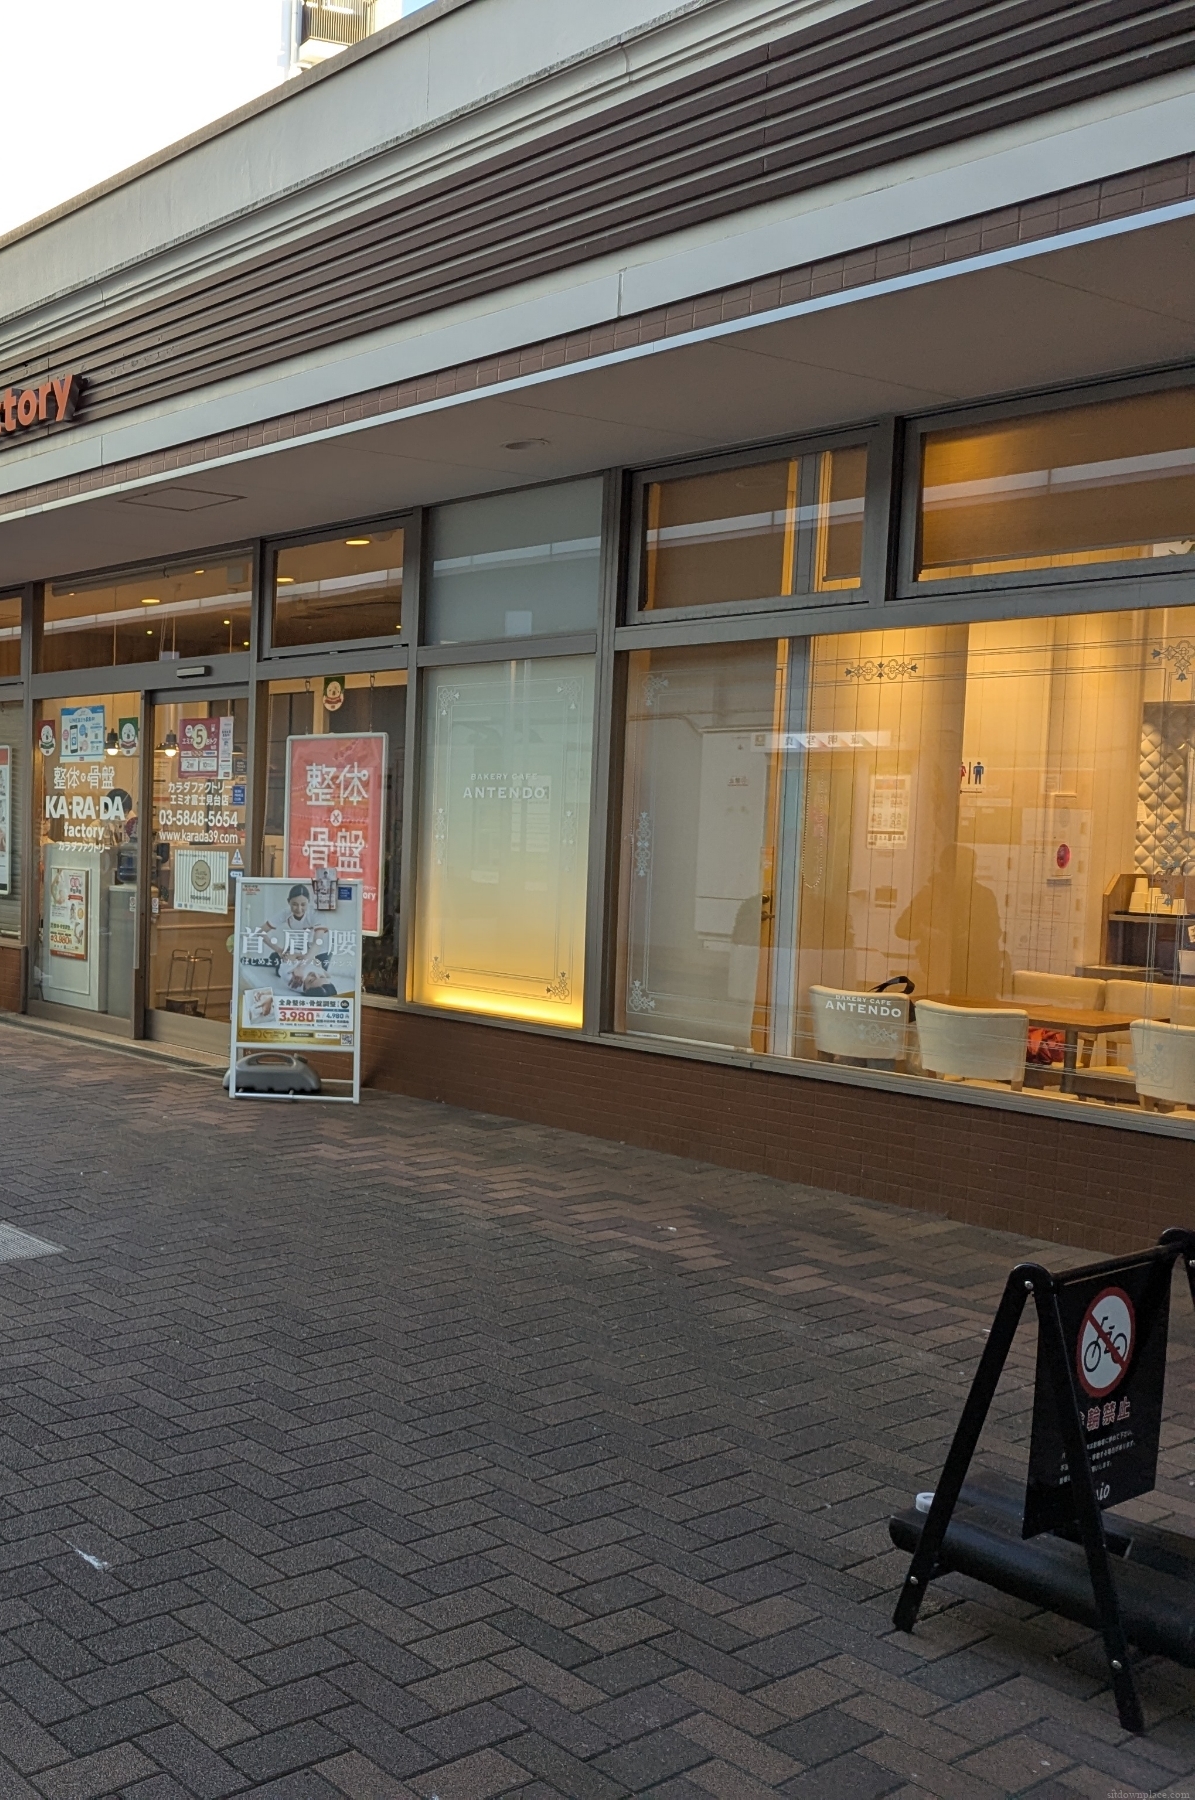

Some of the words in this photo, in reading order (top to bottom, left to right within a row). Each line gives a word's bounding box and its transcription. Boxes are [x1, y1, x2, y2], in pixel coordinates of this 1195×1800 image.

[168, 781, 233, 793] カラダファクトリー
[306, 762, 369, 805] 整体
[170, 794, 229, 806] エミオ富士見台店
[463, 787, 545, 799] ANTENDO
[159, 810, 238, 827] 03-5848-5654
[64, 822, 105, 840] factory
[159, 829, 238, 844] www.karada39.com
[57, 841, 111, 853] カラダファクトリー
[302, 827, 365, 872] 骨盤
[240, 927, 357, 956] 首・肩・腰
[835, 994, 866, 1003] BAKERY
[869, 998, 892, 1006] CAFE
[825, 1000, 902, 1018] ANTENDO
